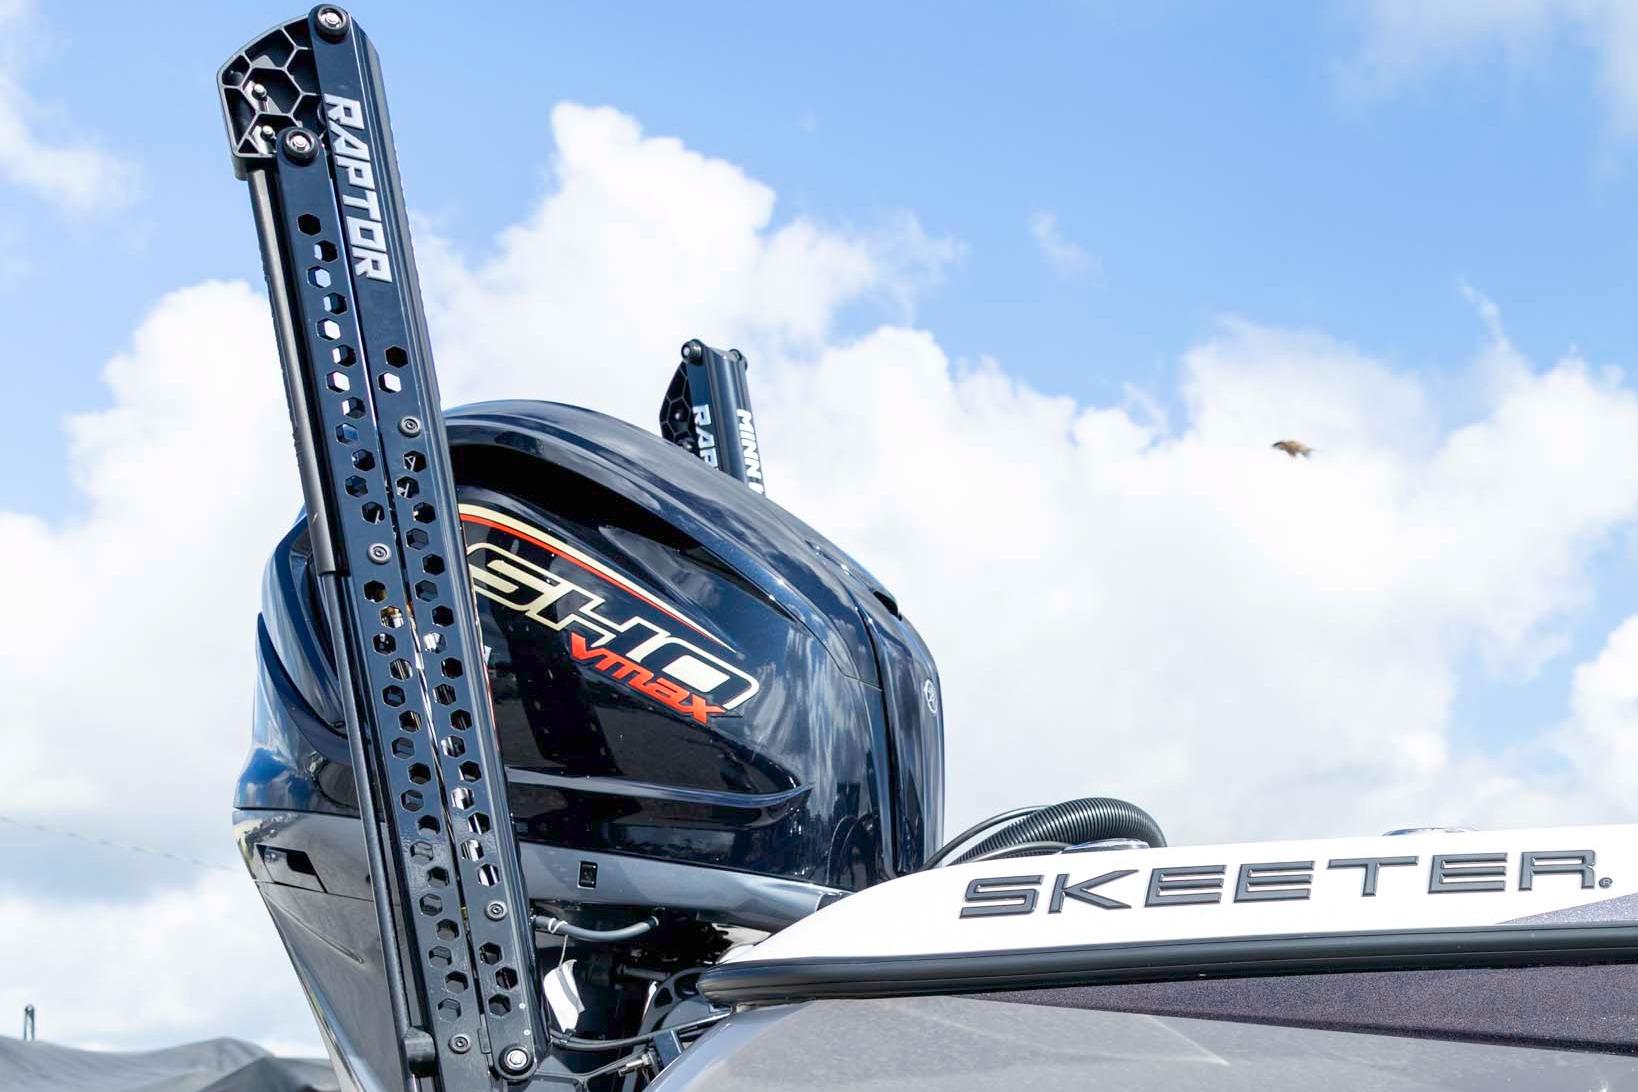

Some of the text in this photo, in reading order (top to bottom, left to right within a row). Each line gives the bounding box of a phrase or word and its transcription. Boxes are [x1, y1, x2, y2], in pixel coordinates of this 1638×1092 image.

[324, 93, 393, 283] RAPTOR
[692, 404, 720, 471] RAP
[736, 408, 762, 480] MINN
